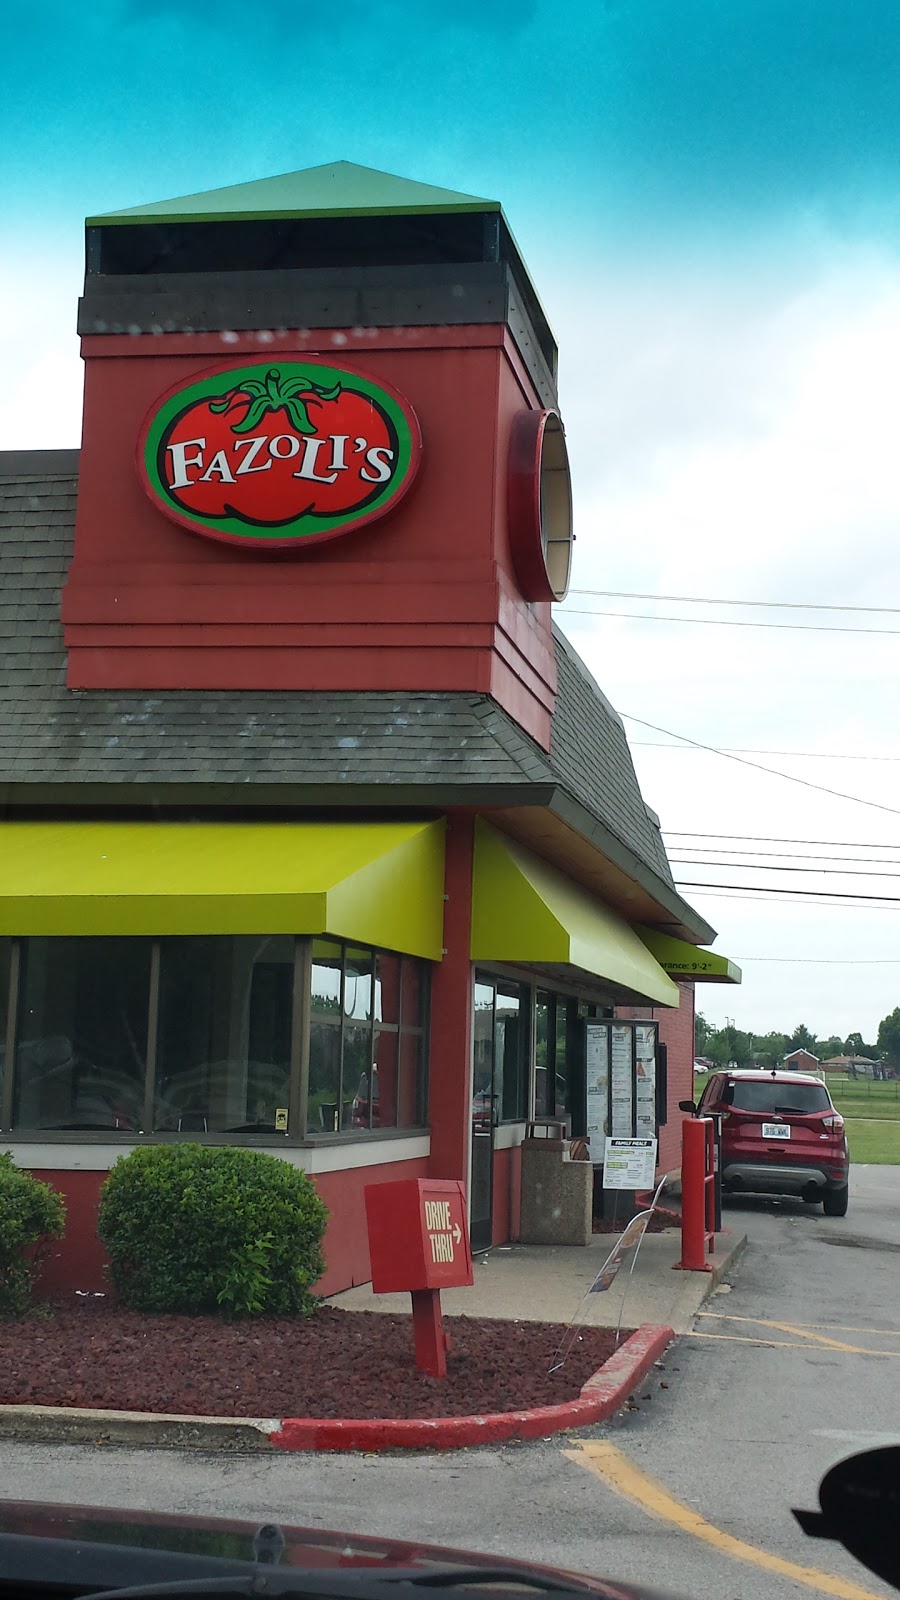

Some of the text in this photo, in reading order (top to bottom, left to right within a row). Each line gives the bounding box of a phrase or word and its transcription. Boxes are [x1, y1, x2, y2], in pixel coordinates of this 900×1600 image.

[167, 434, 395, 489] FAZOLI'S
[424, 1201, 452, 1230] DRIVE
[429, 1234, 454, 1263] THRU
